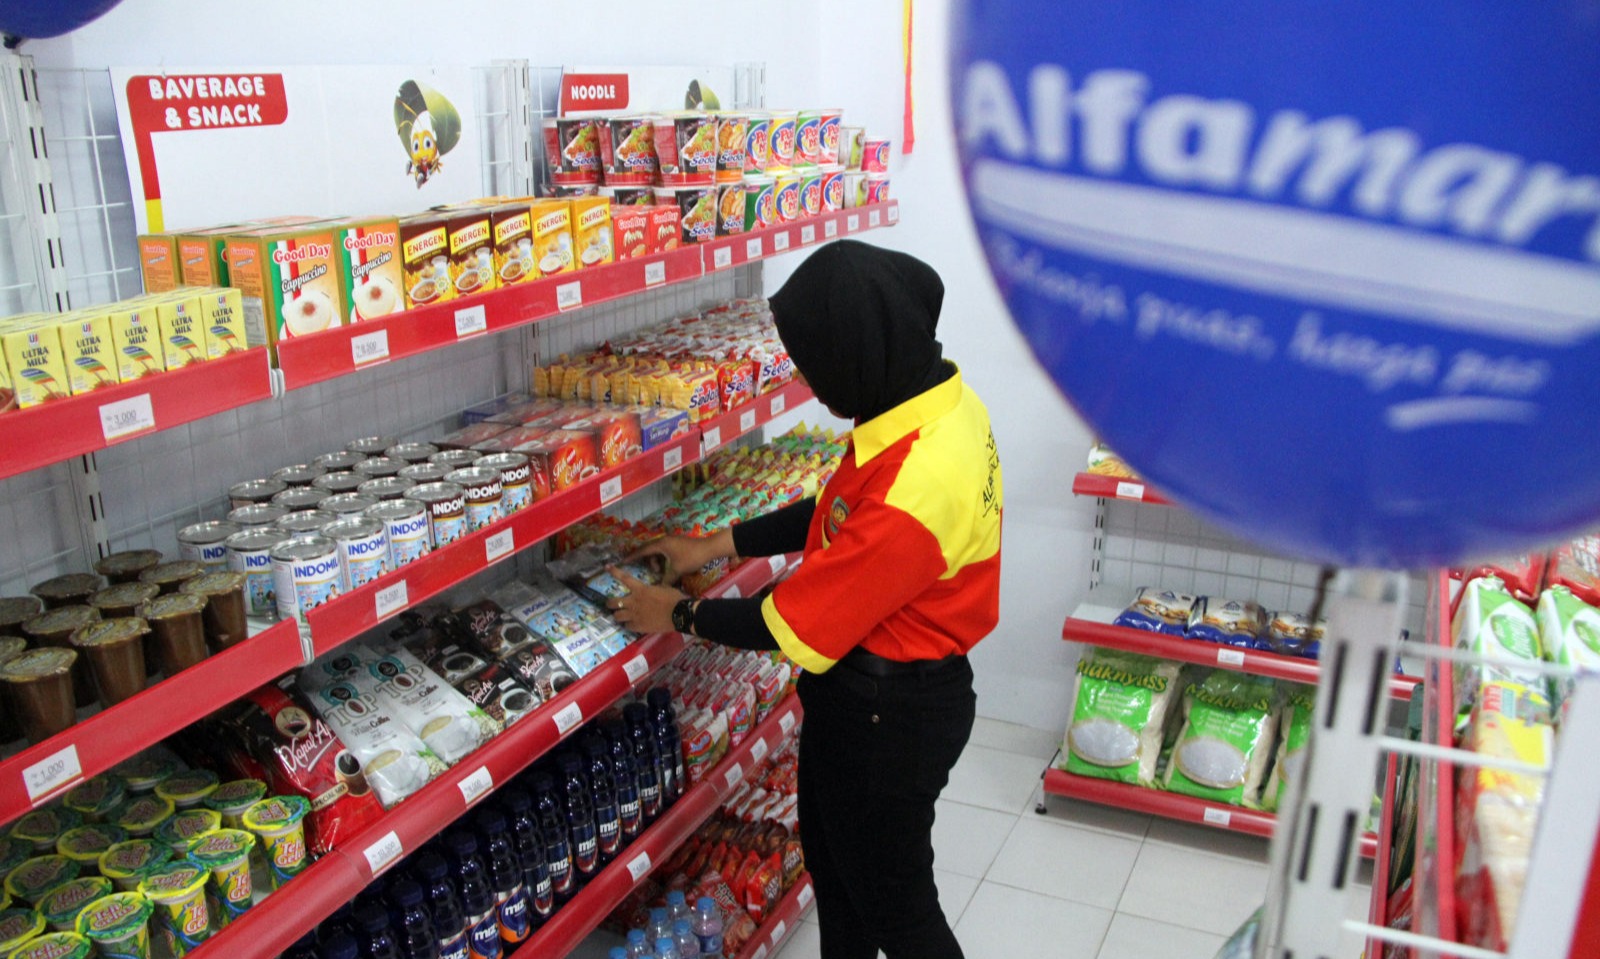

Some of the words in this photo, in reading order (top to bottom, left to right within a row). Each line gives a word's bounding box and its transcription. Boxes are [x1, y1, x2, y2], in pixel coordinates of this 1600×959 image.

[148, 75, 267, 101] BAVERAGE
[571, 84, 616, 100] NOODLE
[165, 106, 182, 129] &
[188, 103, 262, 128] SNACK
[537, 212, 567, 232] ENERGEN
[580, 208, 608, 225] ENERGEN
[453, 226, 487, 247] ENERGEN
[497, 219, 528, 237] ENERGEN
[343, 234, 373, 250] Good
[374, 232, 396, 248] Day
[407, 233, 444, 257] ENERGEN
[273, 248, 306, 264] Good
[307, 243, 331, 261] Day
[351, 250, 392, 278] Cappuccino
[281, 263, 327, 293] Cappuccino
[212, 306, 233, 318] ULTRA
[215, 315, 232, 326] MILK
[171, 315, 193, 328] ULTRA
[124, 325, 149, 338] ULTRA
[174, 325, 192, 336] MILK
[76, 335, 101, 349] ULTRA
[128, 335, 148, 345] MILK
[21, 346, 50, 360] ULTRA
[80, 346, 101, 357] MILK
[26, 356, 49, 367] MILK
[374, 663, 426, 699] TOP
[322, 691, 379, 727] TOP
